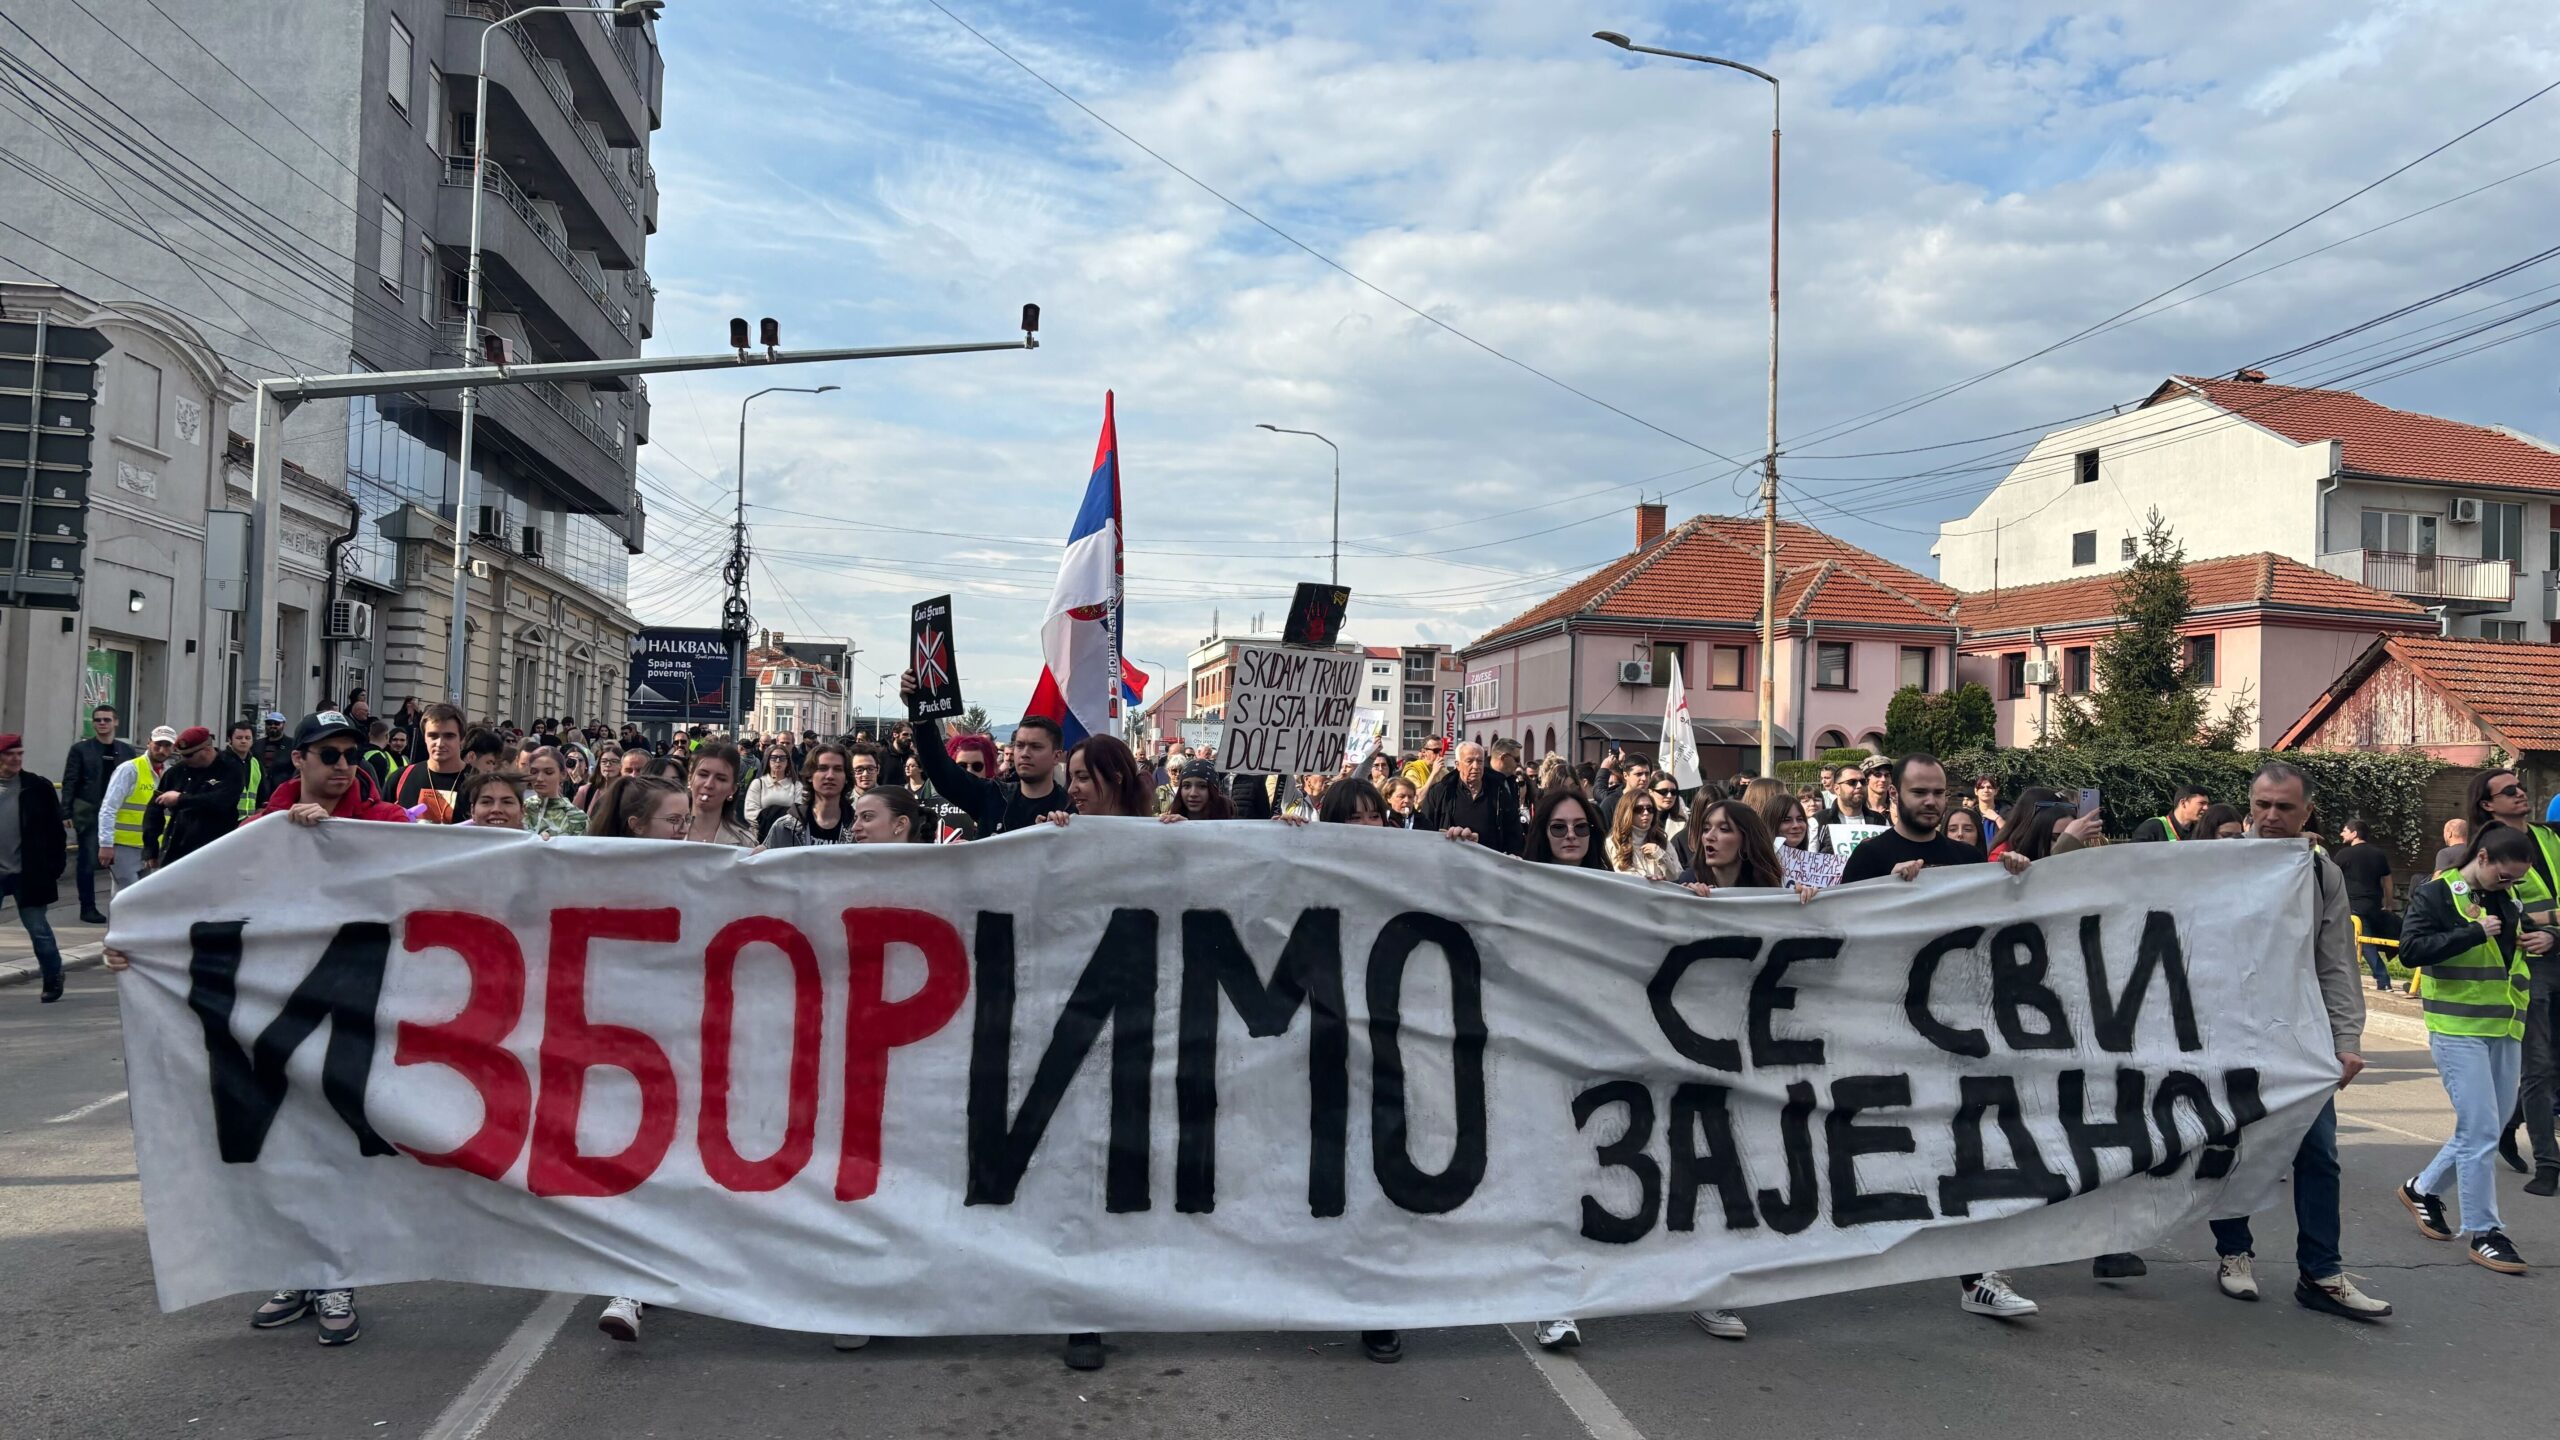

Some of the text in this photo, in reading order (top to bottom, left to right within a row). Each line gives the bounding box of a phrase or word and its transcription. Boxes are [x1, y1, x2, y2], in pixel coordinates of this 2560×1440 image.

[927, 605, 946, 620] Scum
[648, 639, 728, 655] HALKBANK
[647, 658, 673, 670] Spaja
[1239, 650, 1359, 697] SKIDAM TRAKU
[1471, 671, 1493, 684] ZAVESE
[919, 697, 952, 716] Fuck Off
[1446, 692, 1456, 752] ZAVESE
[1225, 727, 1347, 773] DOLE VLADA
[1808, 851, 1820, 864] НЕ
[1647, 910, 2202, 1072] СЕ СВИ
[187, 906, 1488, 1217] ИЗБОРИМО
[1571, 1067, 2268, 1244] ЗАЈЕДНО!
